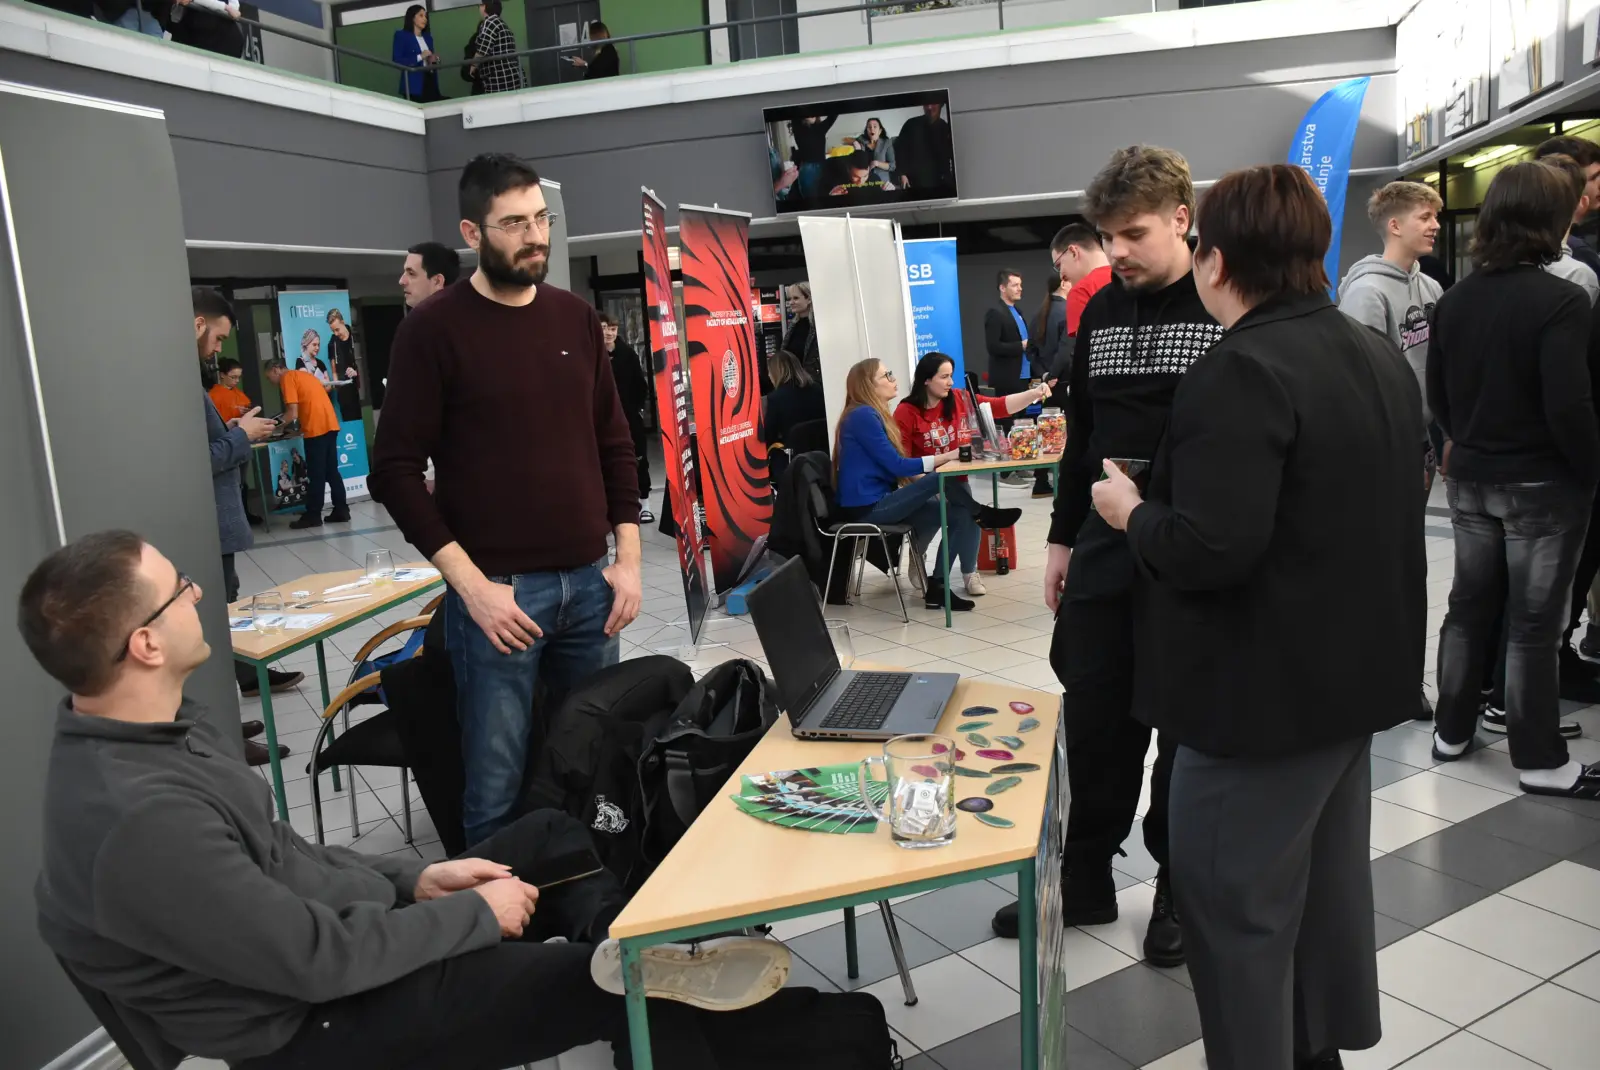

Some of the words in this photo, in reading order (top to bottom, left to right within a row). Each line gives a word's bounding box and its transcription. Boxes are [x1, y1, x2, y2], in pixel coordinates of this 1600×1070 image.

[1316, 156, 1333, 194] adnje
[906, 264, 933, 279] SB
[912, 305, 935, 313] Zagrebu
